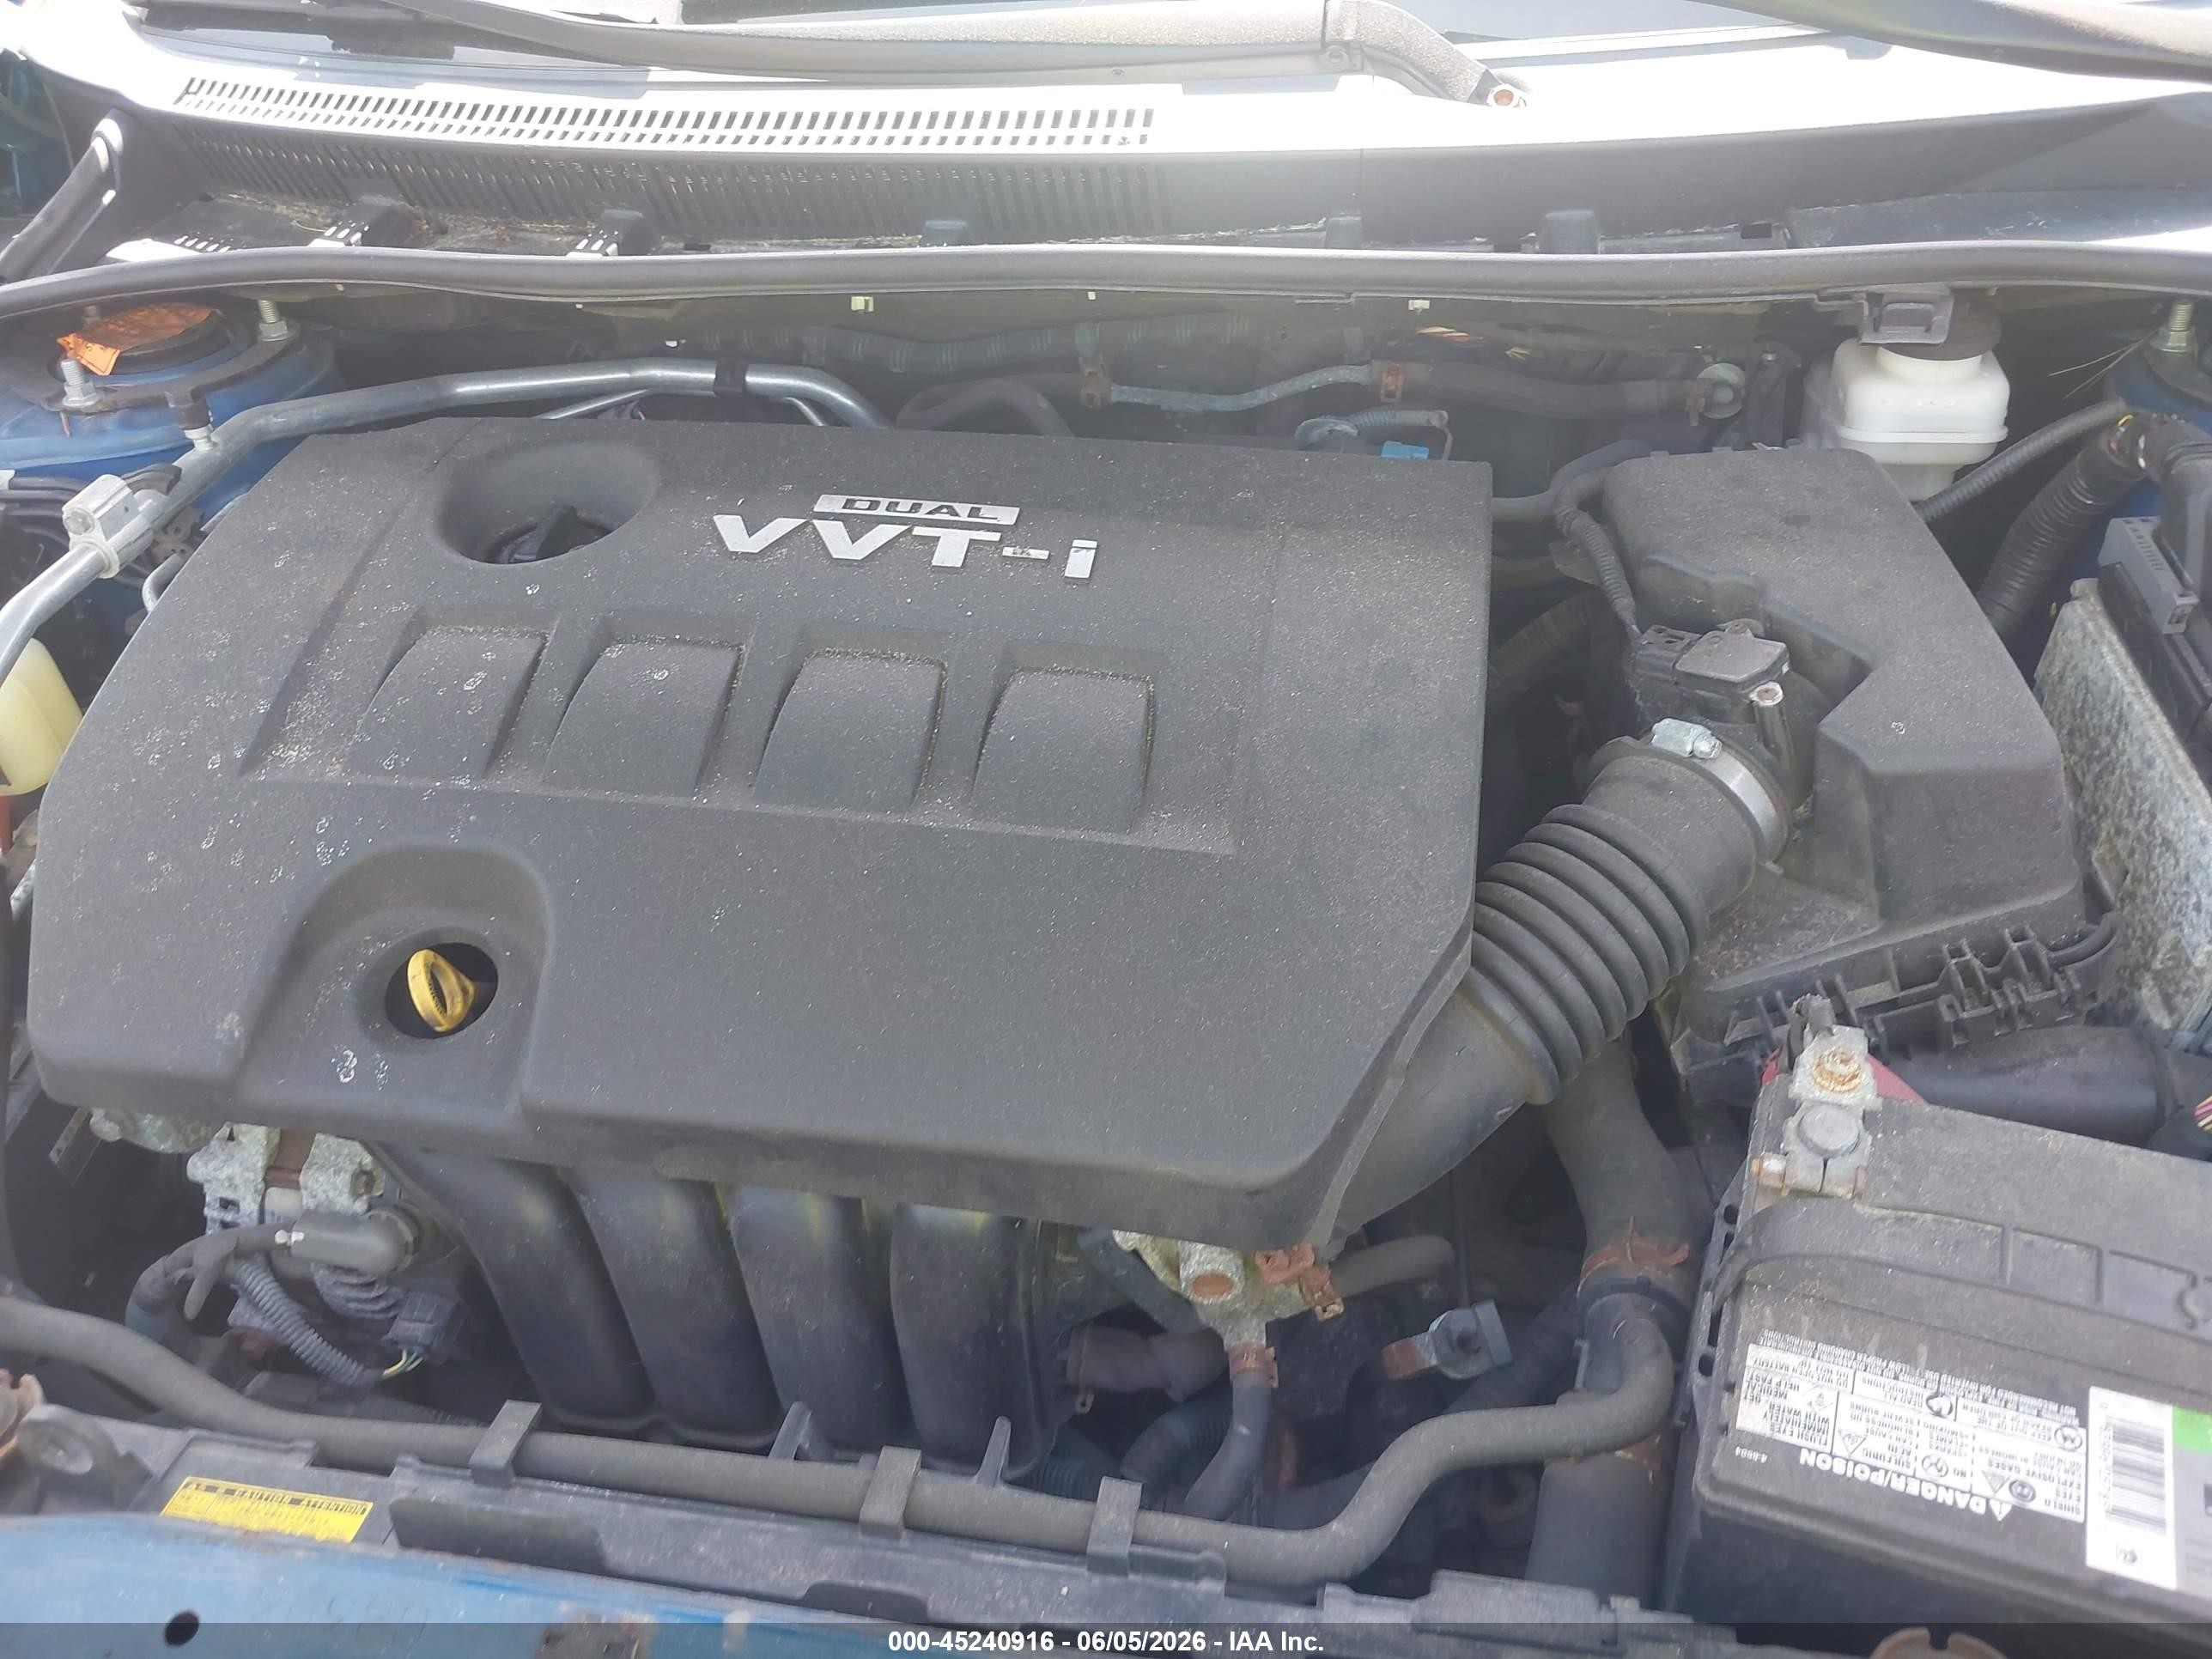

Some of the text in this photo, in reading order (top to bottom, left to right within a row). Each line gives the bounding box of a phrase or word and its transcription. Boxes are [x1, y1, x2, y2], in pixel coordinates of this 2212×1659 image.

[841, 497, 999, 520] DUAL
[713, 514, 1098, 580] VVT-i
[1800, 1448, 1986, 1515] DANGER/POISON
